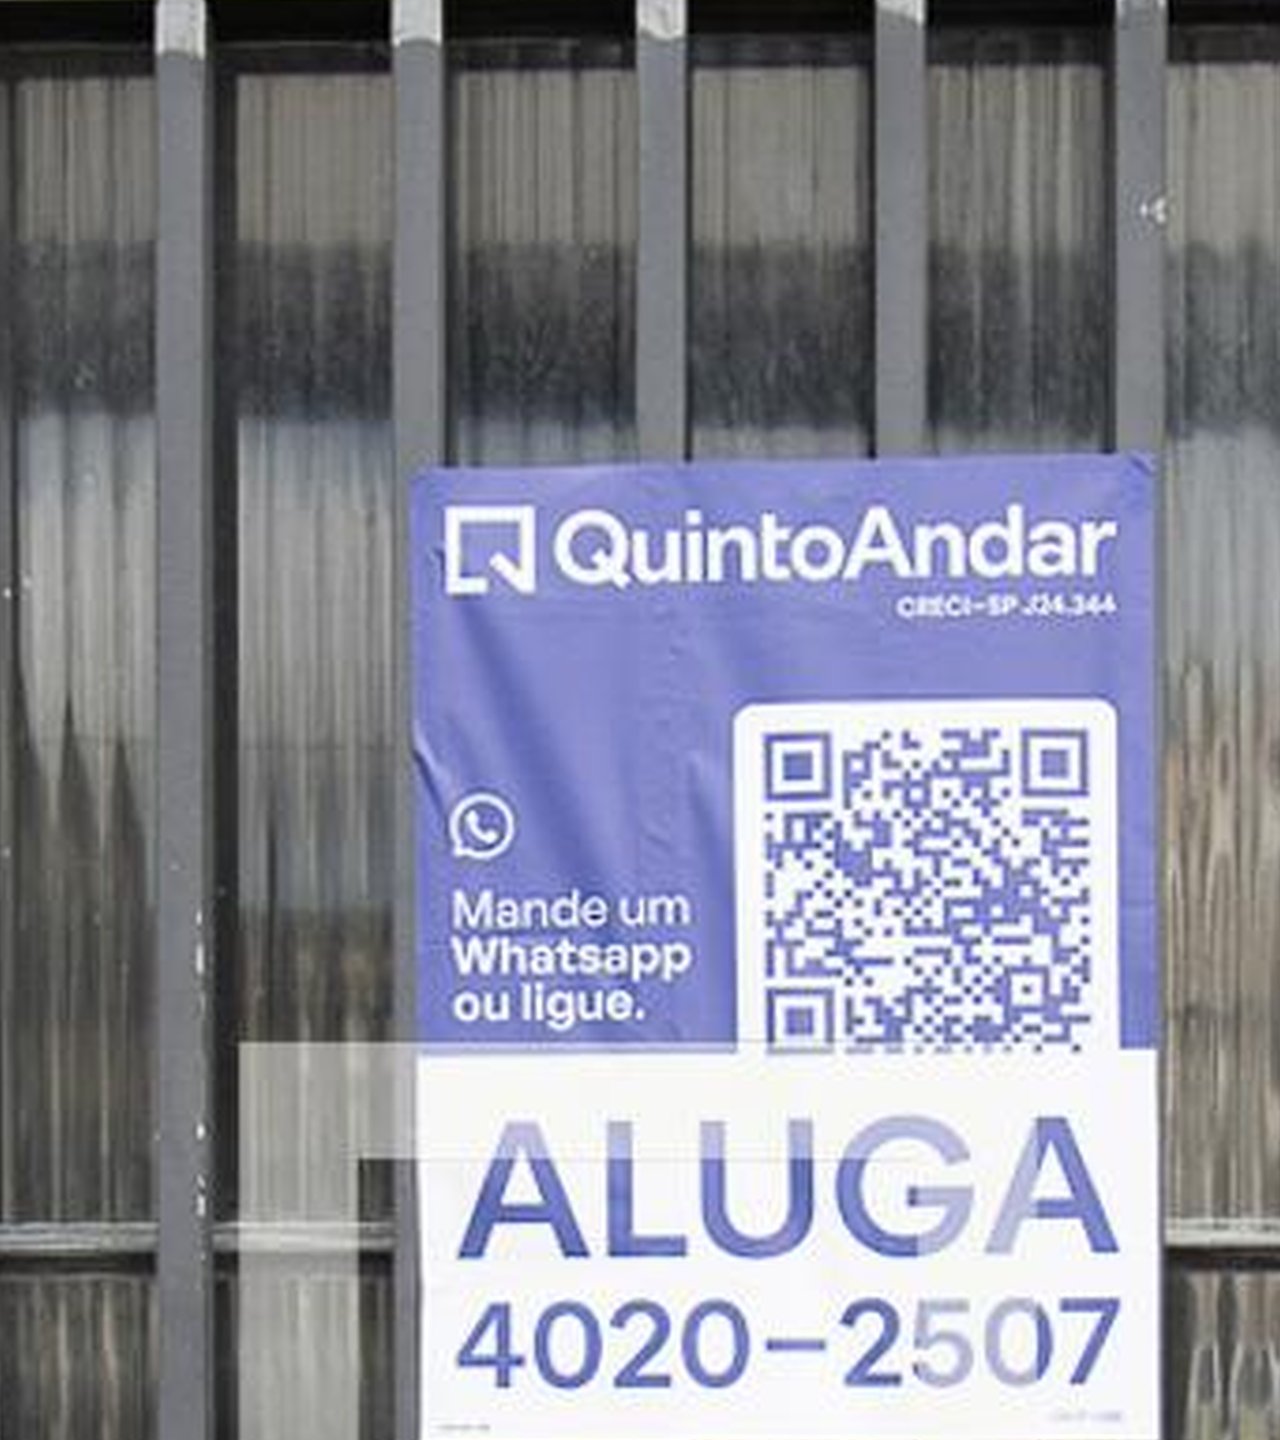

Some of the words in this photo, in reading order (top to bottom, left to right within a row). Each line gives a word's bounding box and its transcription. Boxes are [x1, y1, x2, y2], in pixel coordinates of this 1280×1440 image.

[552, 502, 1120, 590] QuintoAndar
[452, 887, 609, 930] Mande
[619, 894, 692, 926] um
[450, 934, 694, 983] Whatsapp
[452, 988, 511, 1023] ou
[520, 981, 647, 1033] ligue.
[455, 1115, 1122, 1262] ALUGA
[455, 1298, 1123, 1390] 4020-2507
